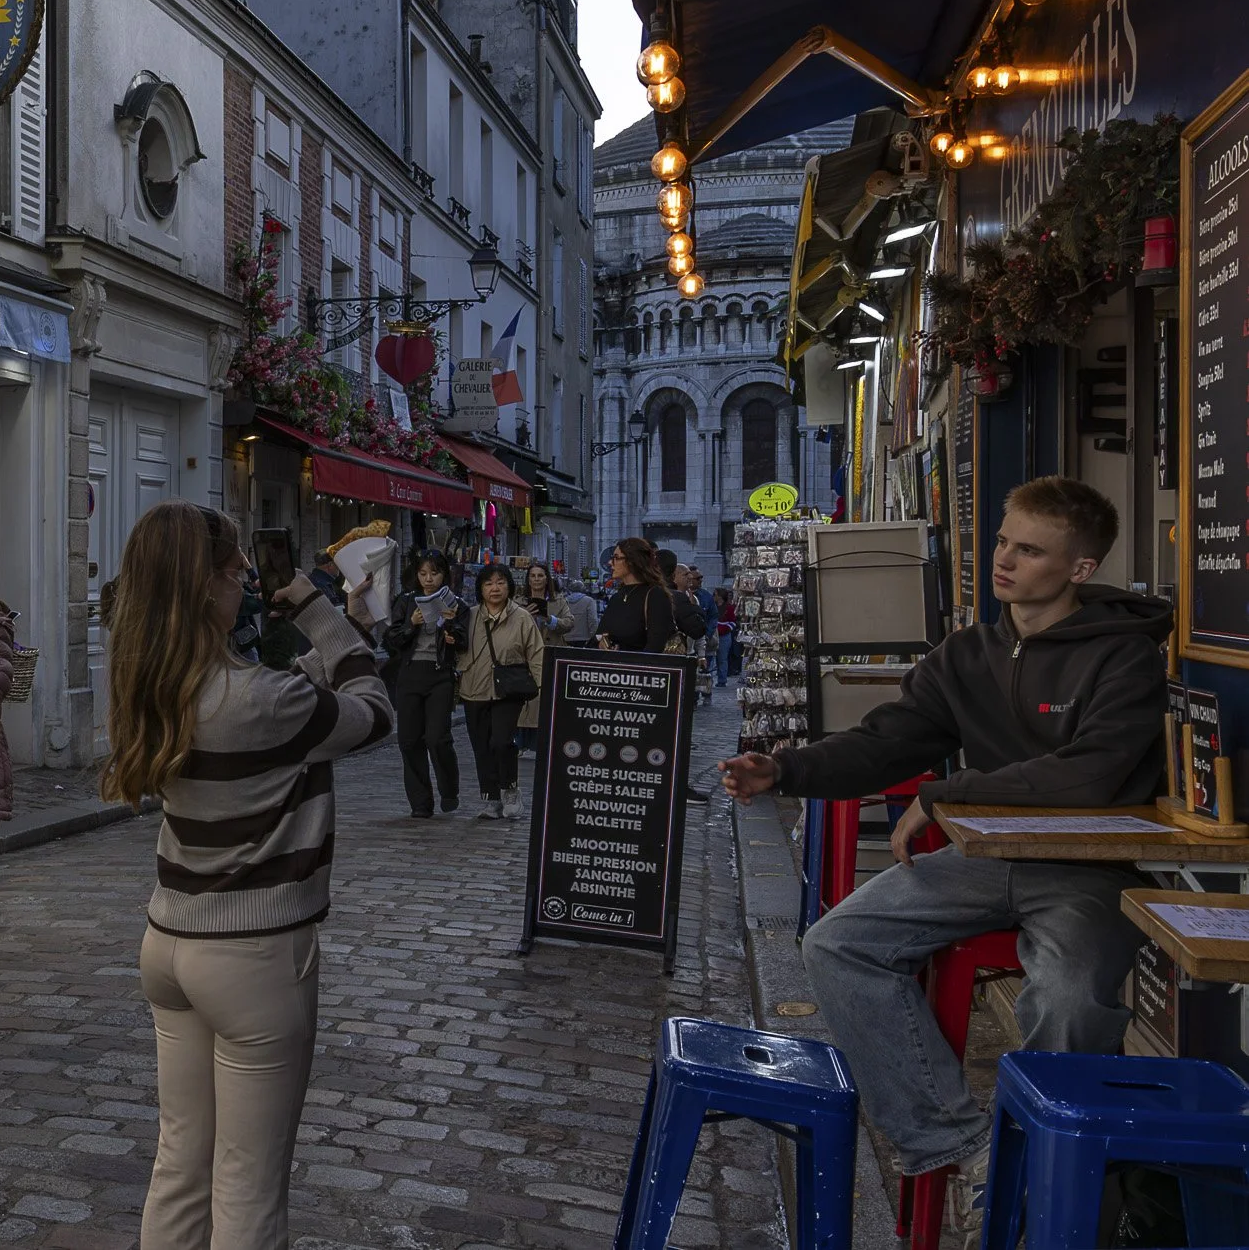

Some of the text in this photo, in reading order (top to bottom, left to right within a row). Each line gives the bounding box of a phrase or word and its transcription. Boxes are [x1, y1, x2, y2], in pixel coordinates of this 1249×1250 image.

[1208, 134, 1249, 191] ALCOOLS
[458, 361, 492, 372] GALERIE
[454, 383, 491, 394] CHEVALIER
[755, 501, 763, 511] 3
[570, 670, 667, 689] GRENOUILLES
[578, 686, 652, 702] Welcome's You
[576, 707, 657, 725] TAKE AWAY
[589, 724, 640, 739] ON SITE
[566, 763, 662, 785] CRÊPE SUCREE
[569, 780, 655, 800] CRÊPE SALEE
[573, 798, 647, 816] SANDWICH
[575, 813, 642, 831] RACLETTE
[570, 837, 639, 855] SMOOTHIE
[552, 851, 657, 874] BIERE PRESSION
[575, 868, 635, 885] SANGRIA
[569, 881, 636, 899] ABSINTHE
[573, 906, 608, 921] Come
[609, 912, 624, 924] in
